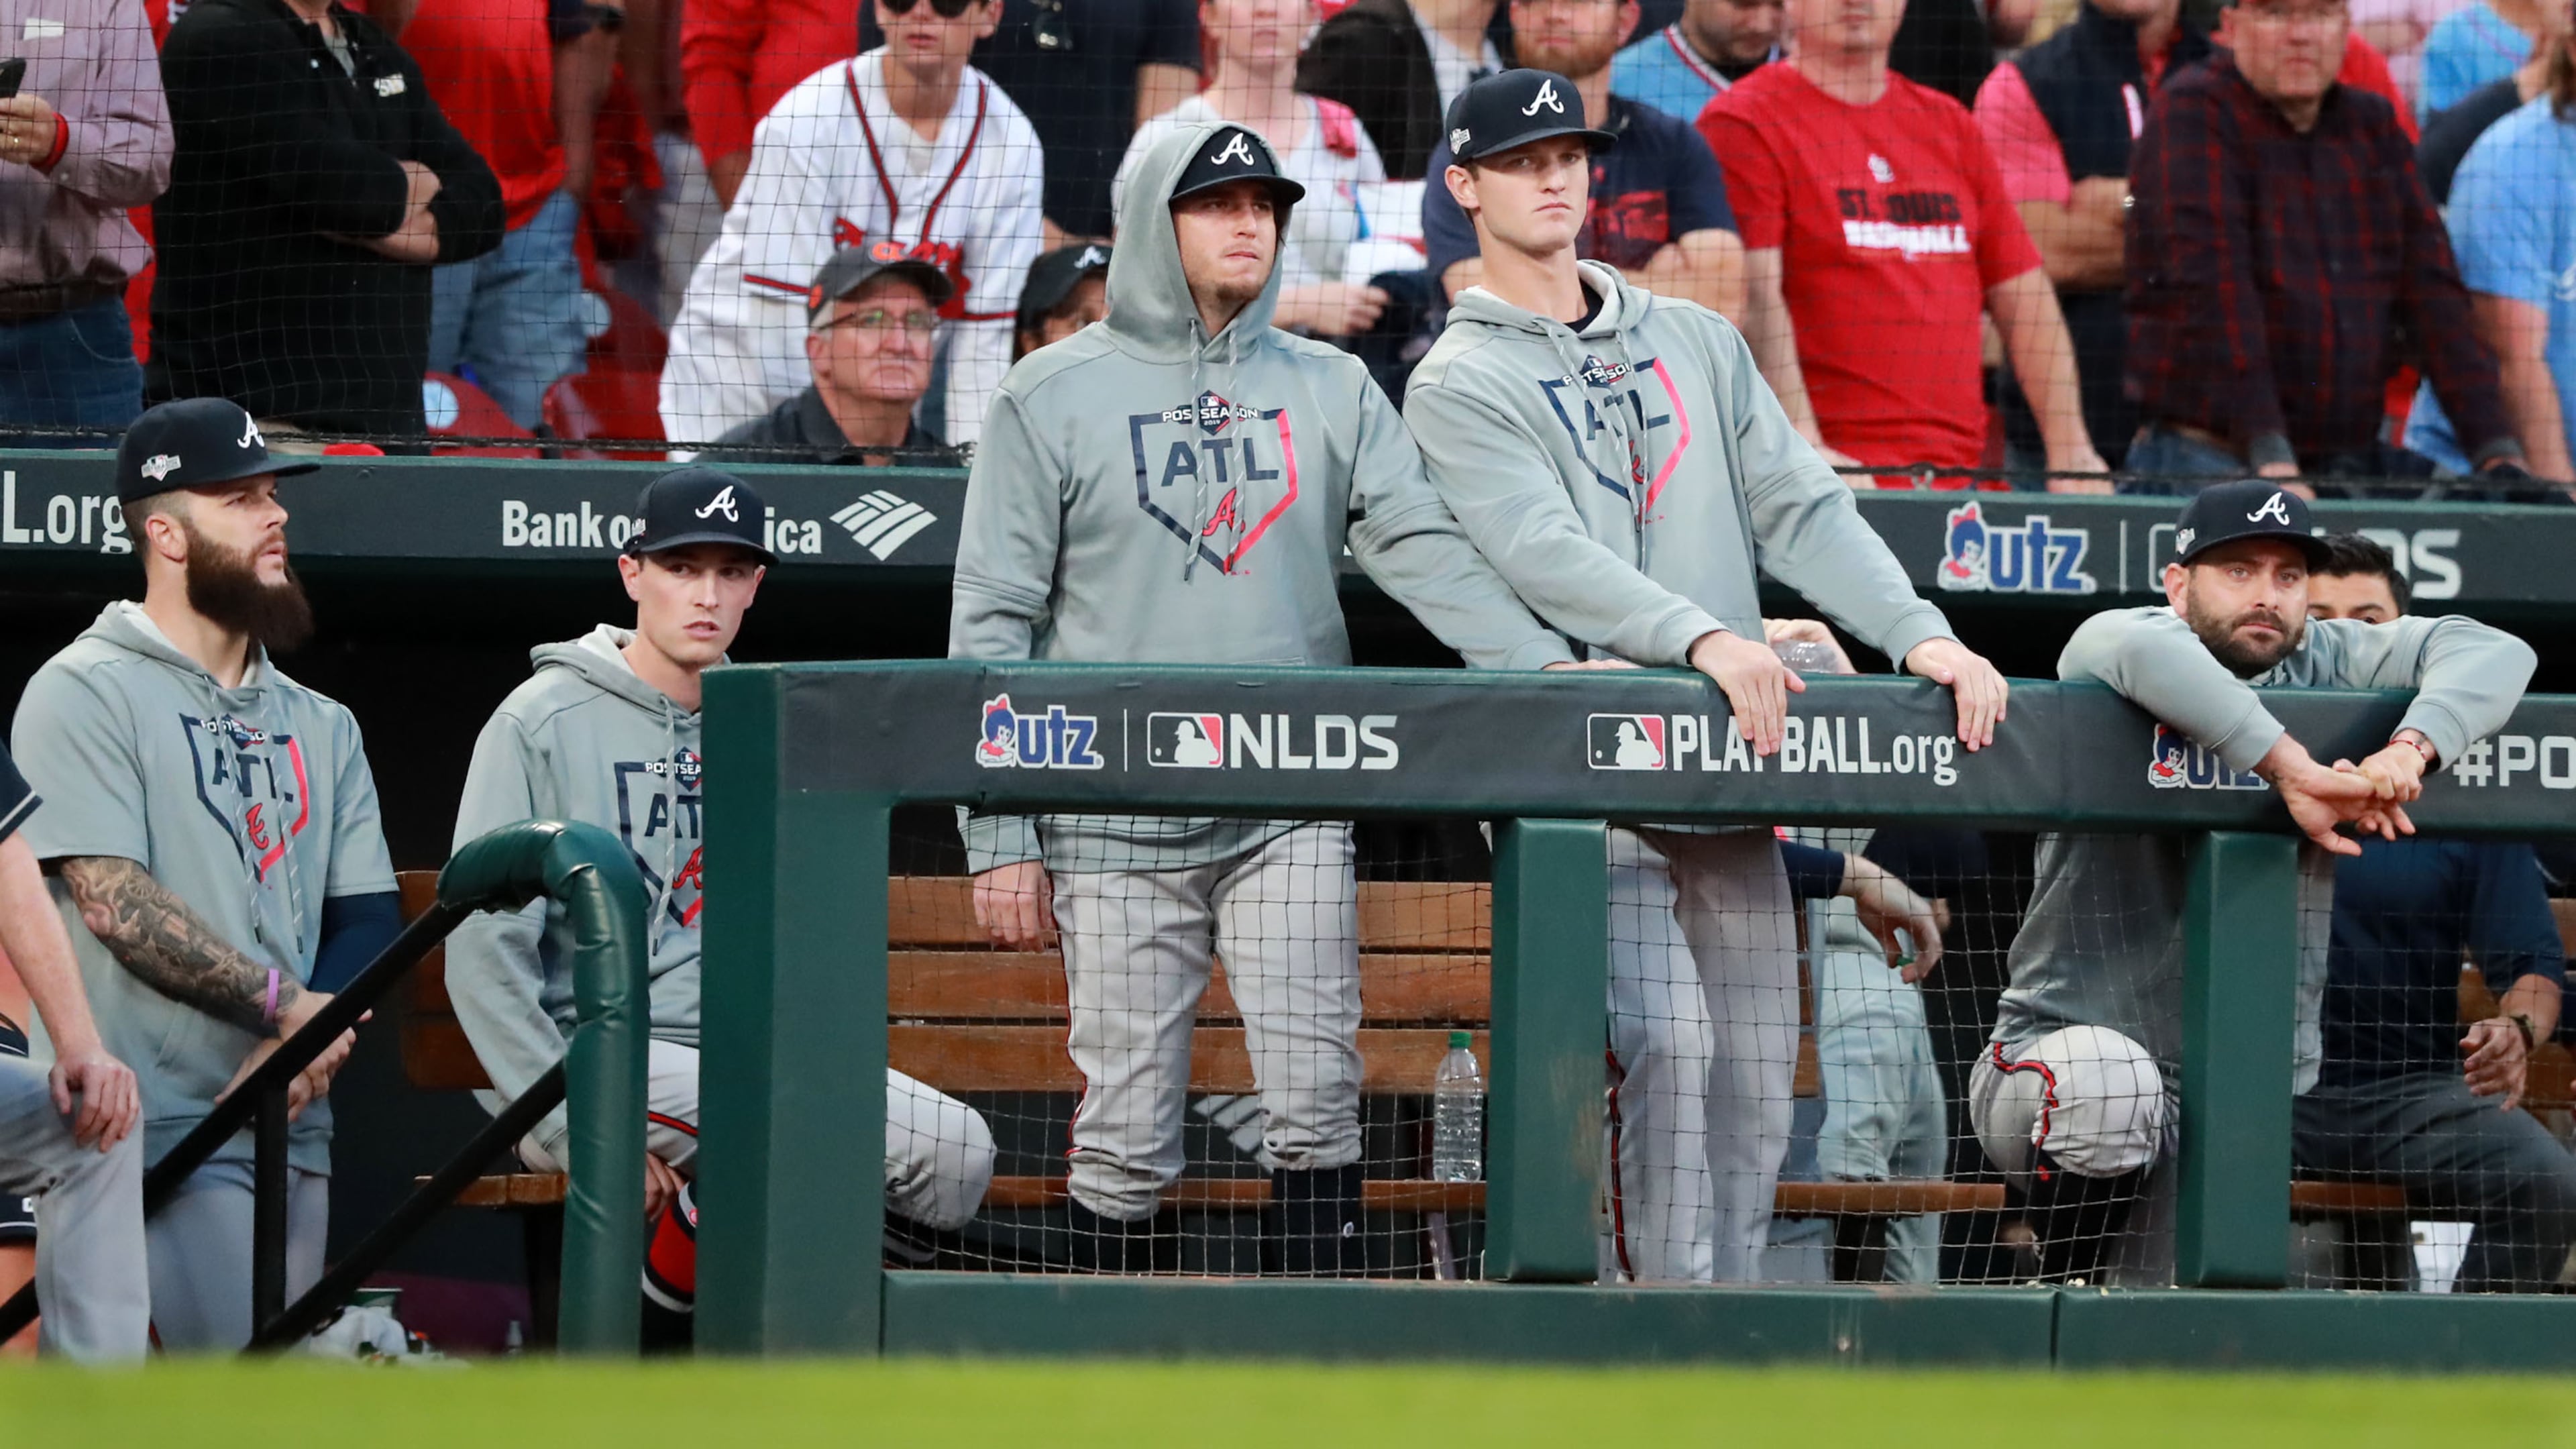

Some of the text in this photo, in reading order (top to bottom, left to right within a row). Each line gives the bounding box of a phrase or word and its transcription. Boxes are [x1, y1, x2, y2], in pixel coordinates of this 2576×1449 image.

[1521, 78, 1564, 116] A
[1211, 132, 1254, 166] A
[237, 411, 265, 449] A
[1161, 437, 1279, 486] ATL
[695, 485, 739, 523] A
[2247, 492, 2290, 526] A
[502, 500, 604, 548] Bank
[1230, 714, 1399, 770] NLDS
